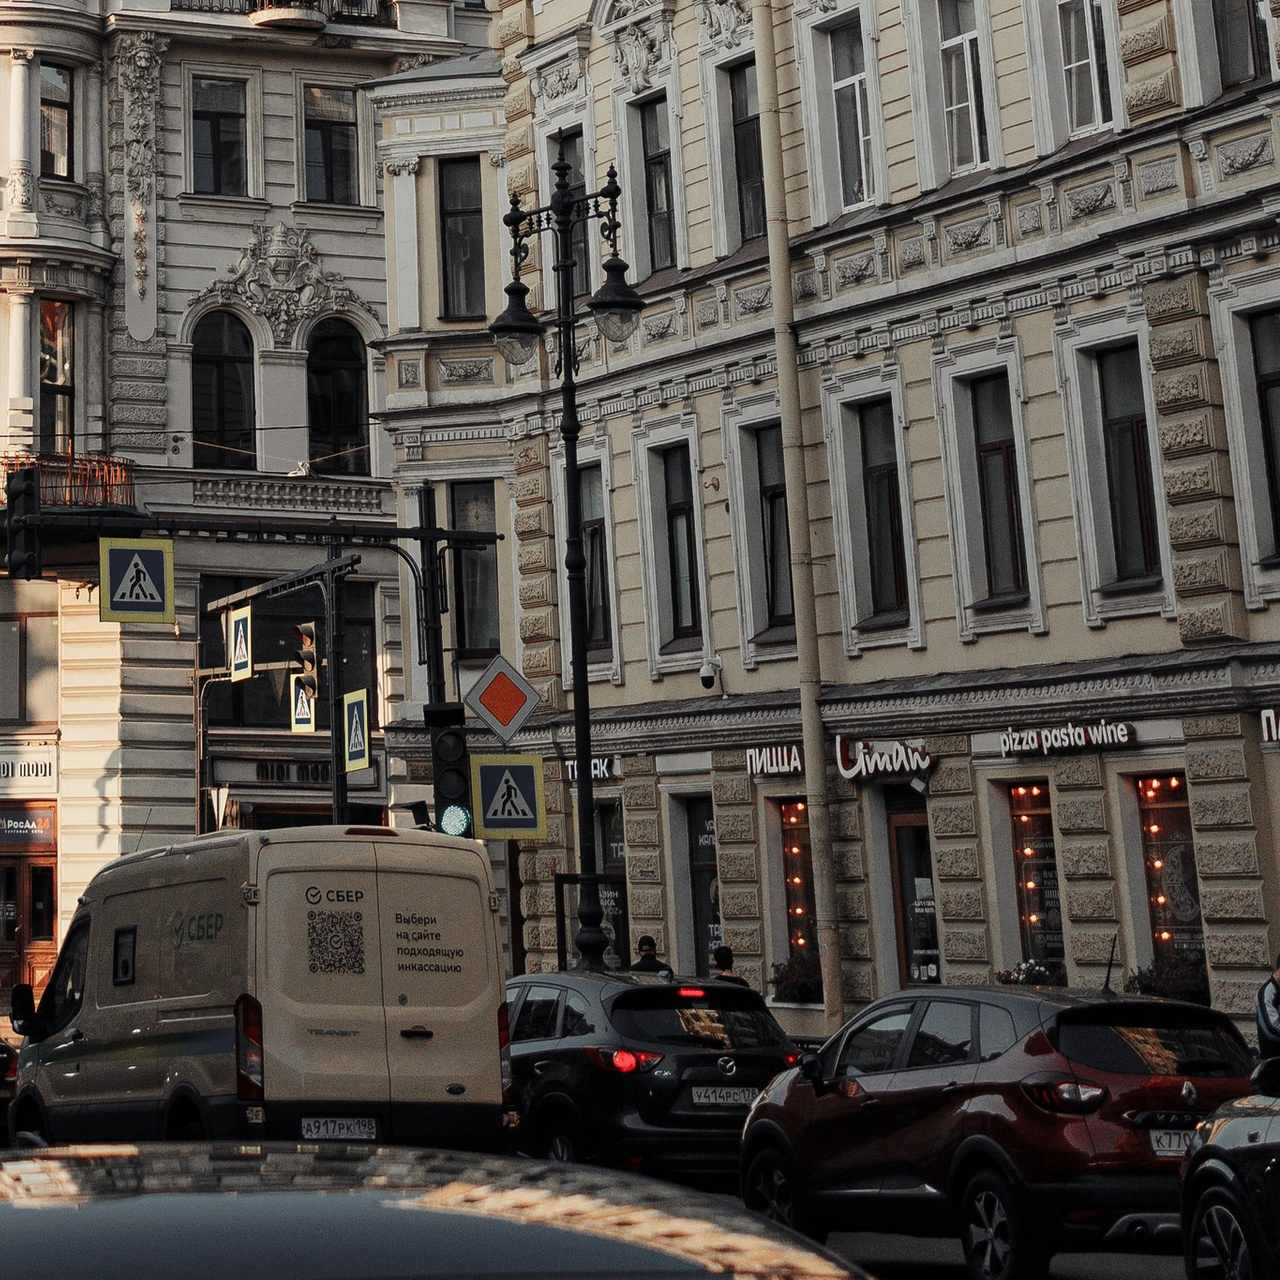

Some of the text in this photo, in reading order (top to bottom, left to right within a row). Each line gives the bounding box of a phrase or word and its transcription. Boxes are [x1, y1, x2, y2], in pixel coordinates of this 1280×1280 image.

[1261, 709, 1280, 741] П
[1000, 718, 1128, 758] pizza pasta wine
[18, 761, 52, 777] MODI
[565, 758, 609, 780] ТАК
[746, 745, 802, 775] ПИЦЦА
[256, 762, 331, 782] MIDI MOD
[326, 890, 364, 902] СБЕР
[187, 913, 224, 942] СБЕР
[395, 913, 437, 926] Выбери
[396, 929, 441, 940] на сайте
[397, 947, 464, 958] подходящую
[398, 963, 462, 974] инкассацию
